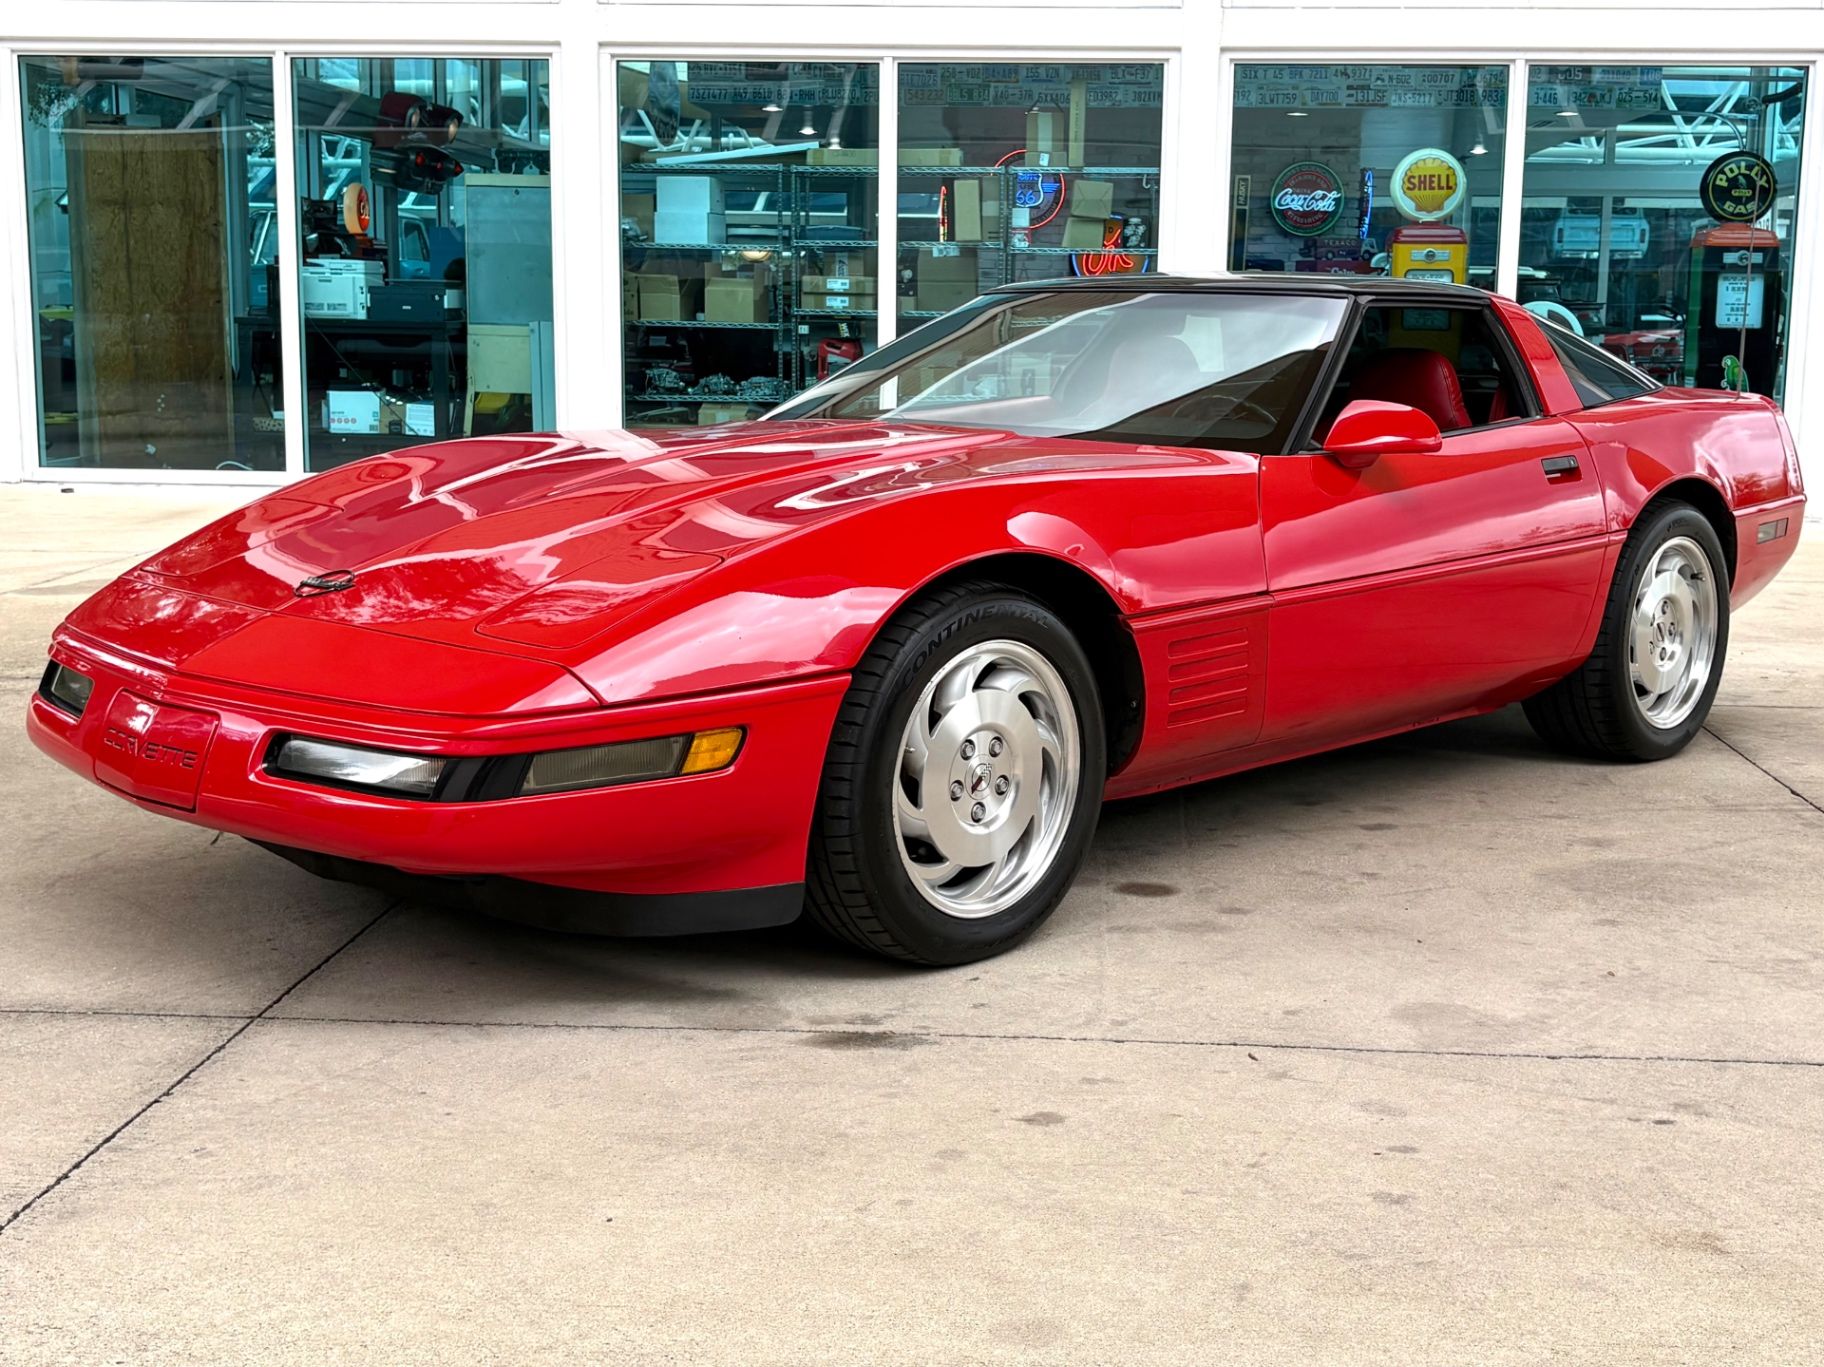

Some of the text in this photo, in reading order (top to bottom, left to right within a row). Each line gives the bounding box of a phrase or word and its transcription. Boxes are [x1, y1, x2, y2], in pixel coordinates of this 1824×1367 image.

[1406, 174, 1453, 191] SHELL
[1715, 161, 1769, 188] POLLY
[1016, 190, 1036, 204] 66
[1723, 200, 1757, 214] GAS
[902, 603, 1049, 690] CONTINENTAL
[104, 727, 199, 771] CORVETTE
